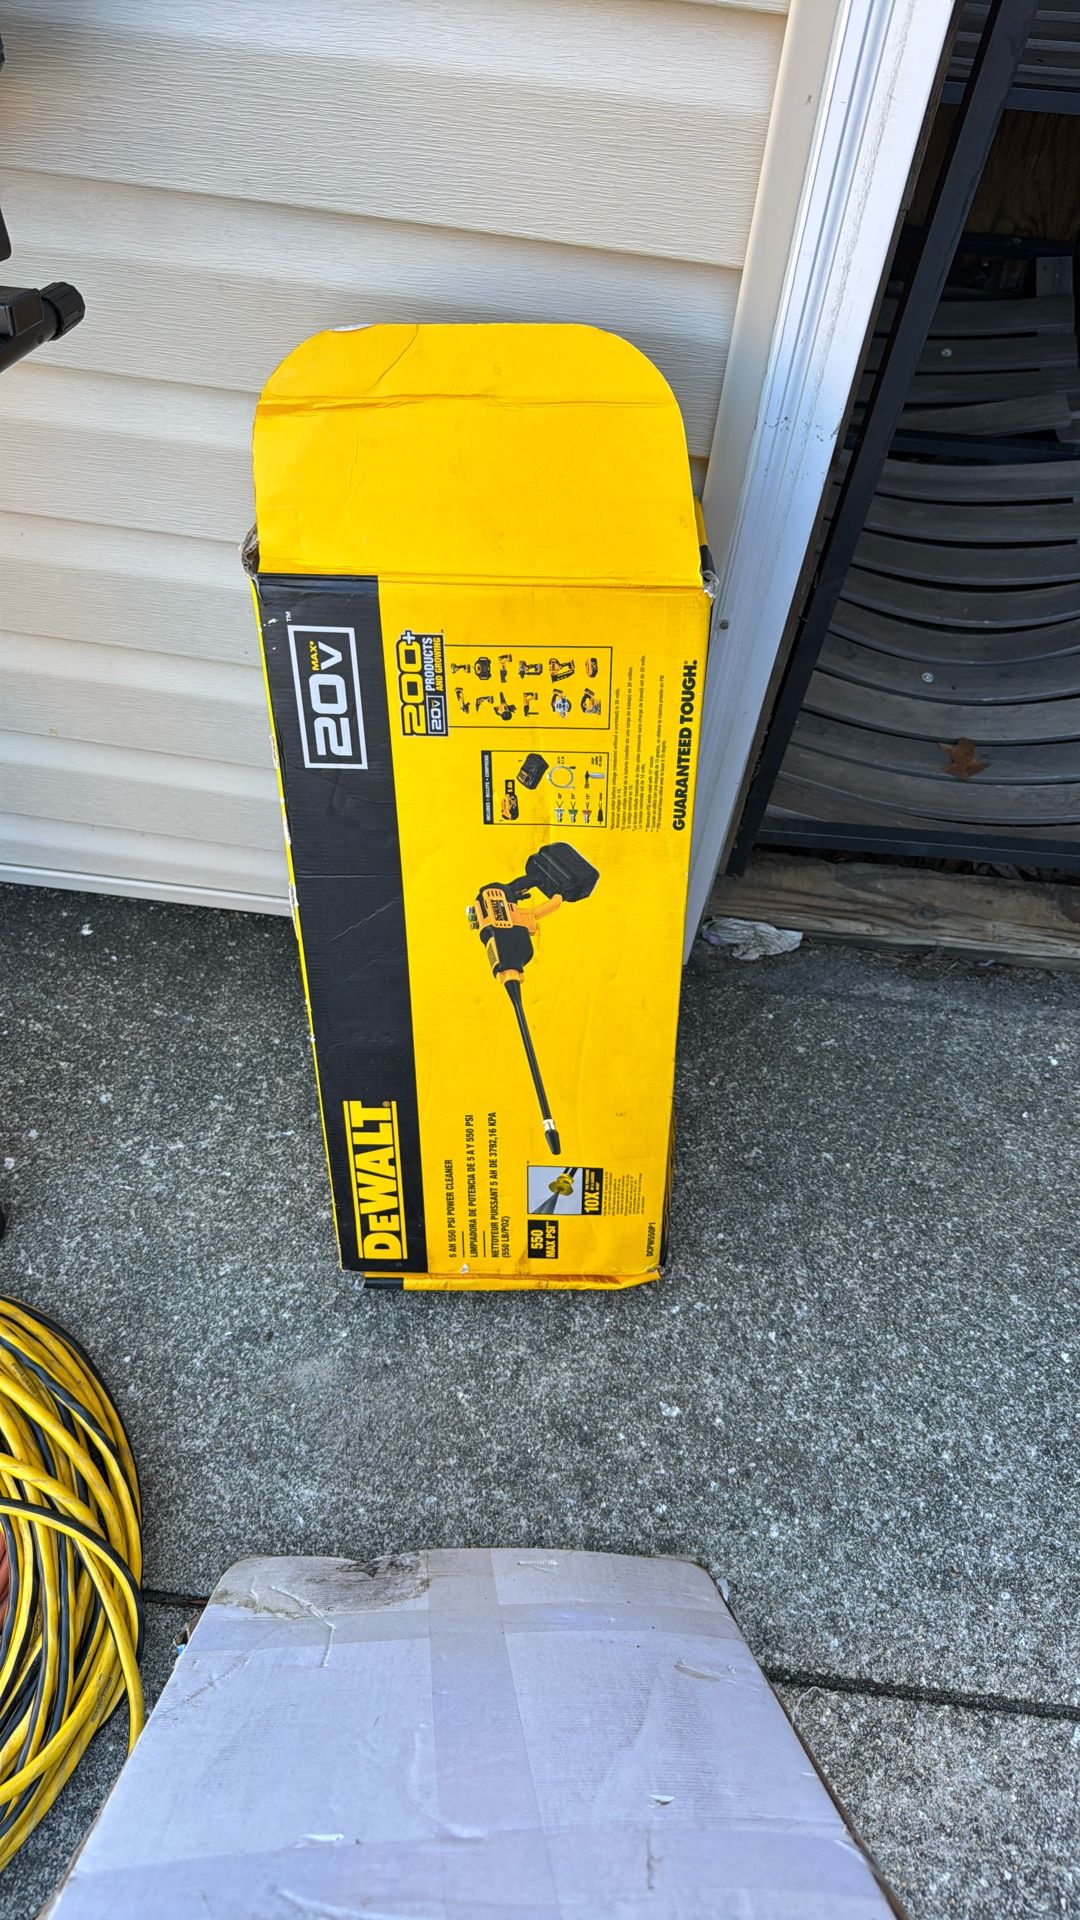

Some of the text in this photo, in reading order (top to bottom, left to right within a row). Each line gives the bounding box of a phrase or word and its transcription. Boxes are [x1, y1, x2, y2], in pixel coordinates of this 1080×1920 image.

[422, 637, 435, 691] PRODUCTS
[433, 638, 443, 691] AND GROWING
[397, 631, 426, 734] 200+
[308, 641, 353, 756] 20V
[431, 699, 442, 730] 20V
[672, 660, 698, 831] GUARANTEED TOUGH.
[465, 1115, 474, 1126] PSI
[487, 1112, 497, 1126] KPA
[465, 1128, 474, 1142] 550
[488, 1128, 499, 1157] 3792,16
[444, 1159, 454, 1190] CLEANER
[466, 1163, 475, 1172] DE
[489, 1159, 497, 1168] DE
[489, 1170, 498, 1179] AH
[349, 1101, 402, 1259] DEWALT
[466, 1174, 476, 1207] POTENCIA
[445, 1192, 455, 1216] POWER
[468, 1208, 477, 1217] DE
[489, 1187, 499, 1220] PUISSANT
[584, 1191, 600, 1213] 10X
[447, 1217, 456, 1228] PSI
[448, 1230, 456, 1242] 550
[468, 1219, 478, 1258] LIMPIADORA
[490, 1222, 500, 1258] NETTOYEUR
[530, 1229, 544, 1249] 550
[448, 1243, 457, 1253] AH
[501, 1243, 511, 1258] (550
[546, 1240, 556, 1258] MAX
